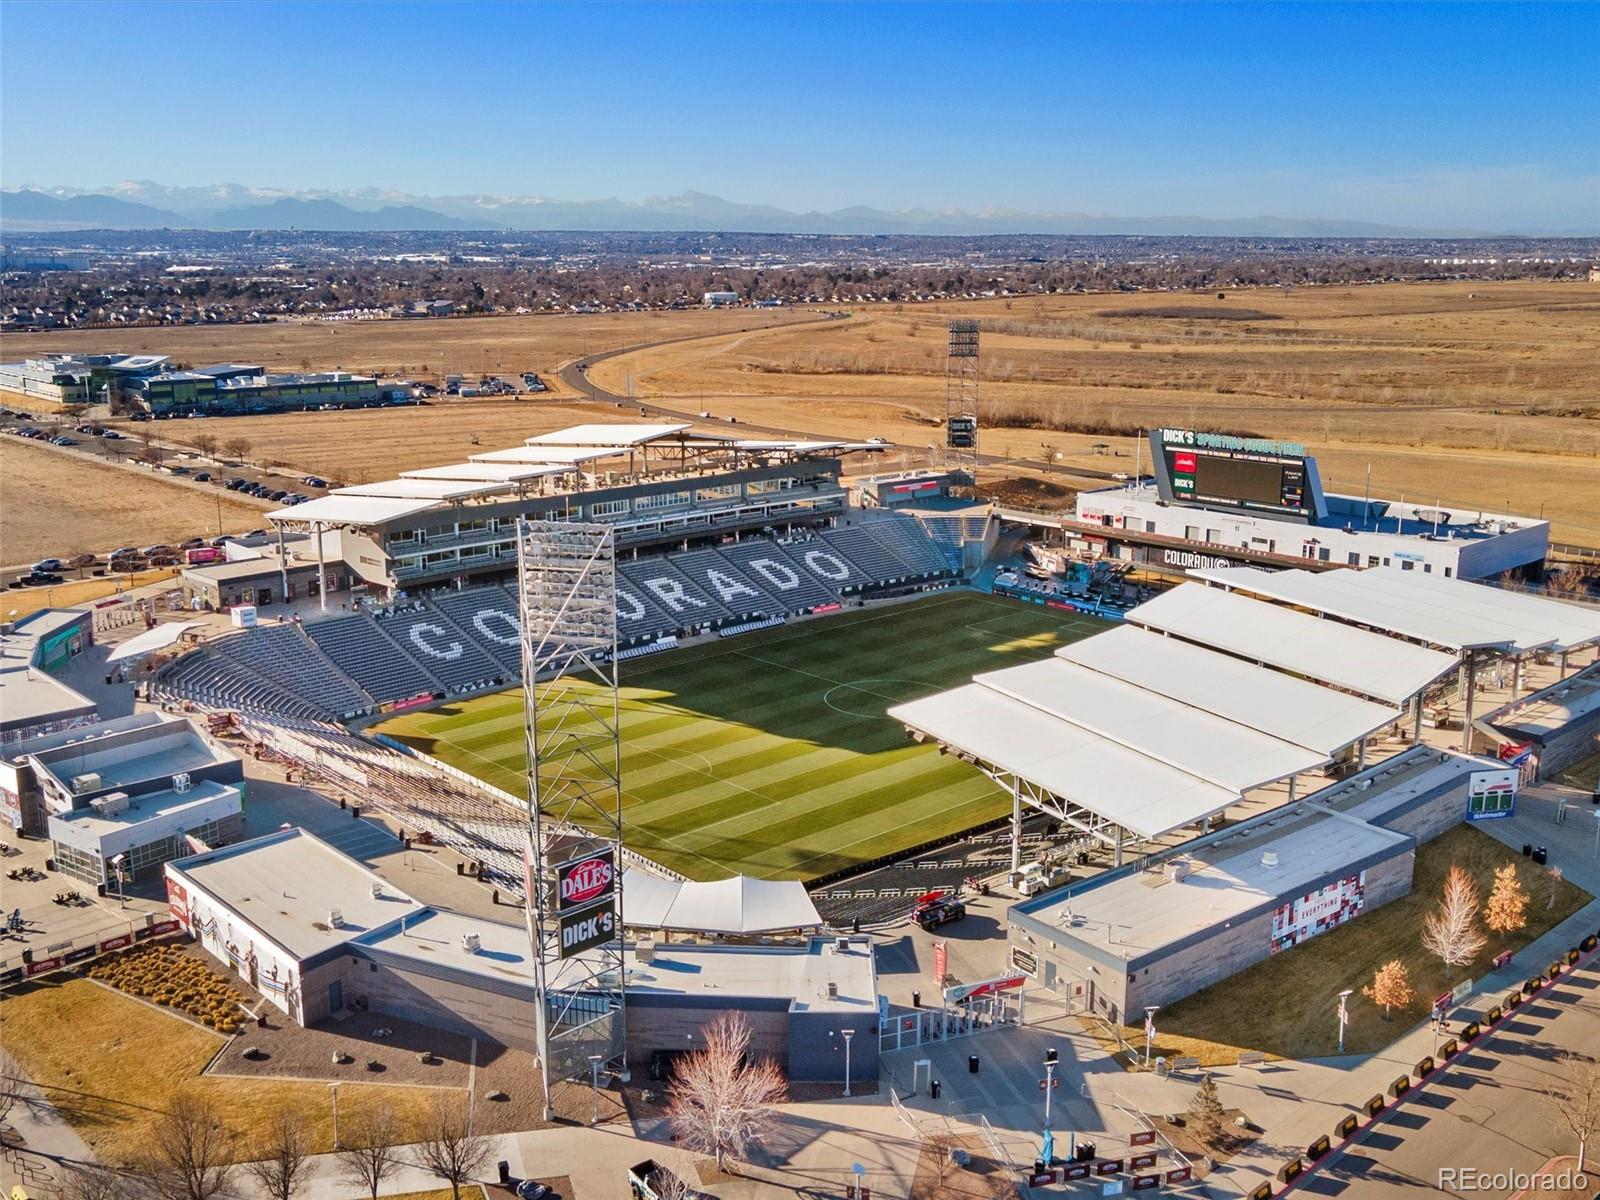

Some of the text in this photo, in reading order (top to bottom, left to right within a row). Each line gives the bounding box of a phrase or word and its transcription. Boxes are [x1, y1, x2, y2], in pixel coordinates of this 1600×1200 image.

[1163, 428, 1194, 444] DICK'S
[1174, 478, 1194, 489] DICK'S
[561, 863, 613, 899] DALE'S
[1302, 896, 1338, 920] EVERYTHING
[563, 911, 613, 948] DICK'S
